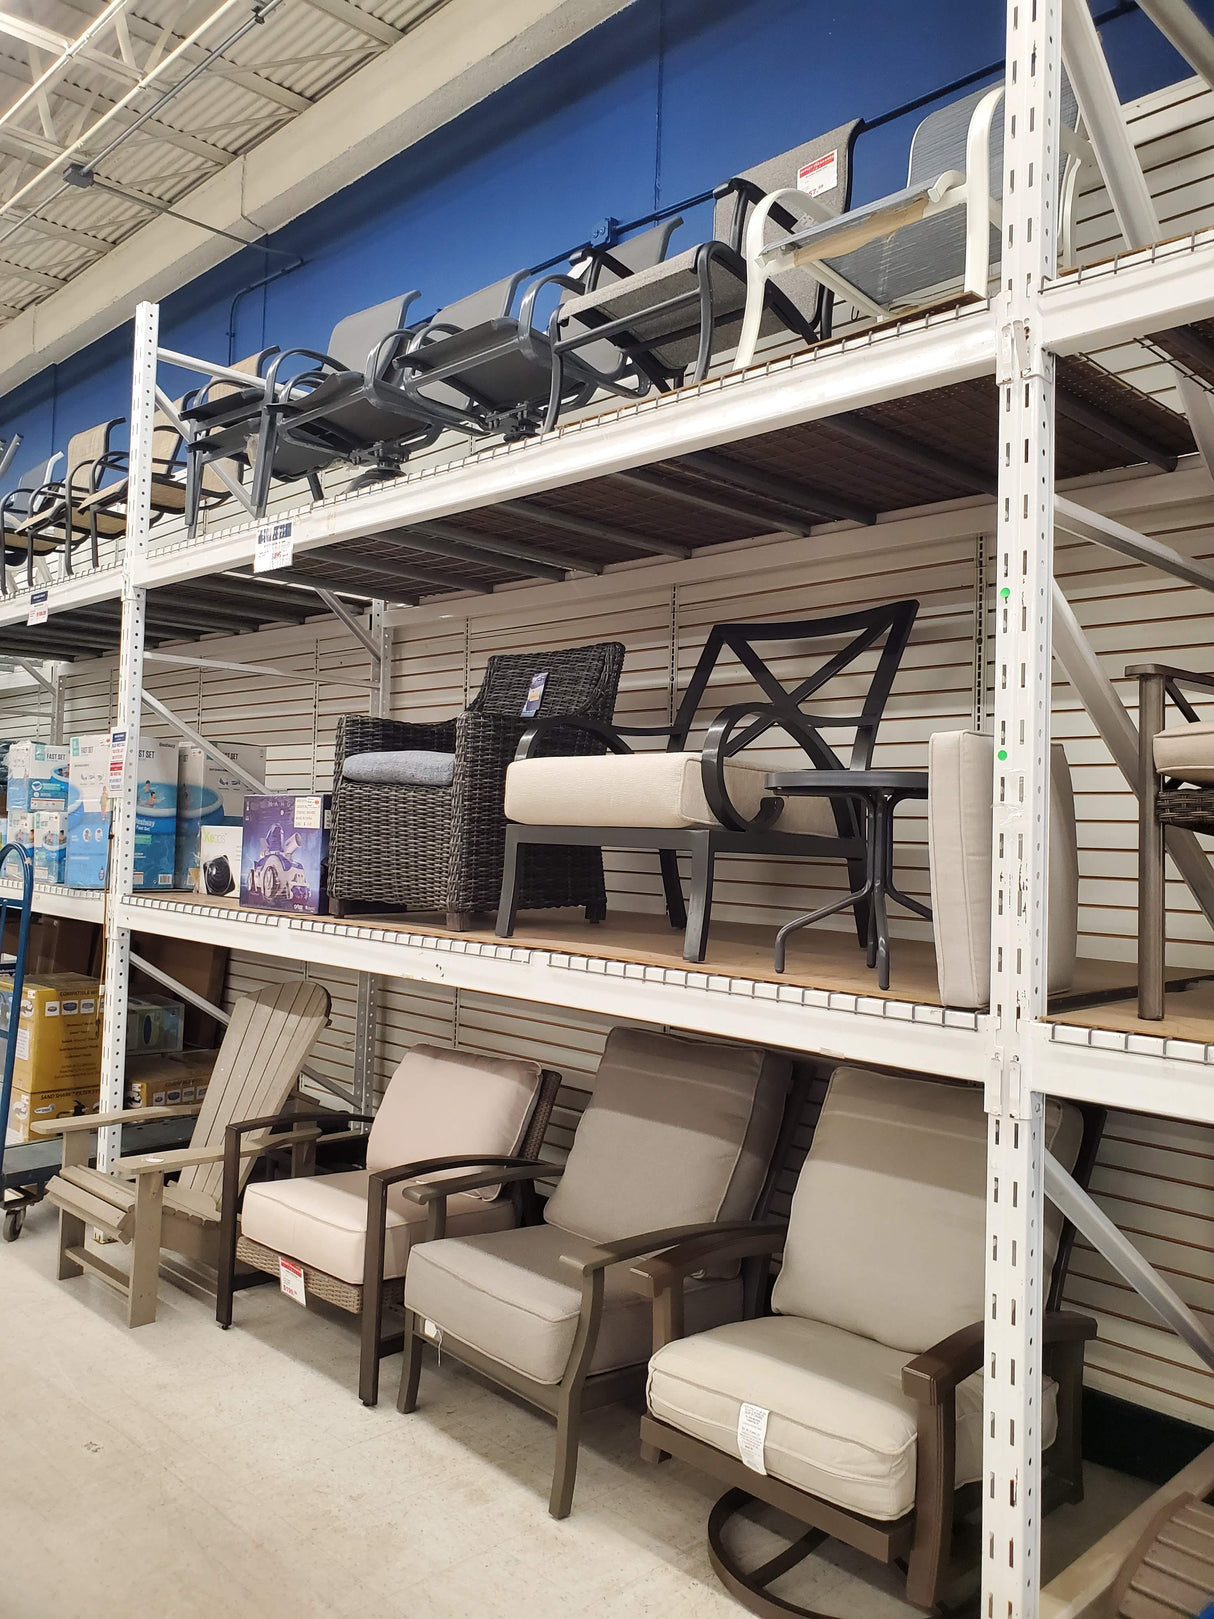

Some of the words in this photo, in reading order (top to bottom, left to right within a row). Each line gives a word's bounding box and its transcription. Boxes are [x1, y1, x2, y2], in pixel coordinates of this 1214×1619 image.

[46, 752, 58, 761] FAST
[58, 752, 66, 761] SET
[145, 750, 155, 759] SET
